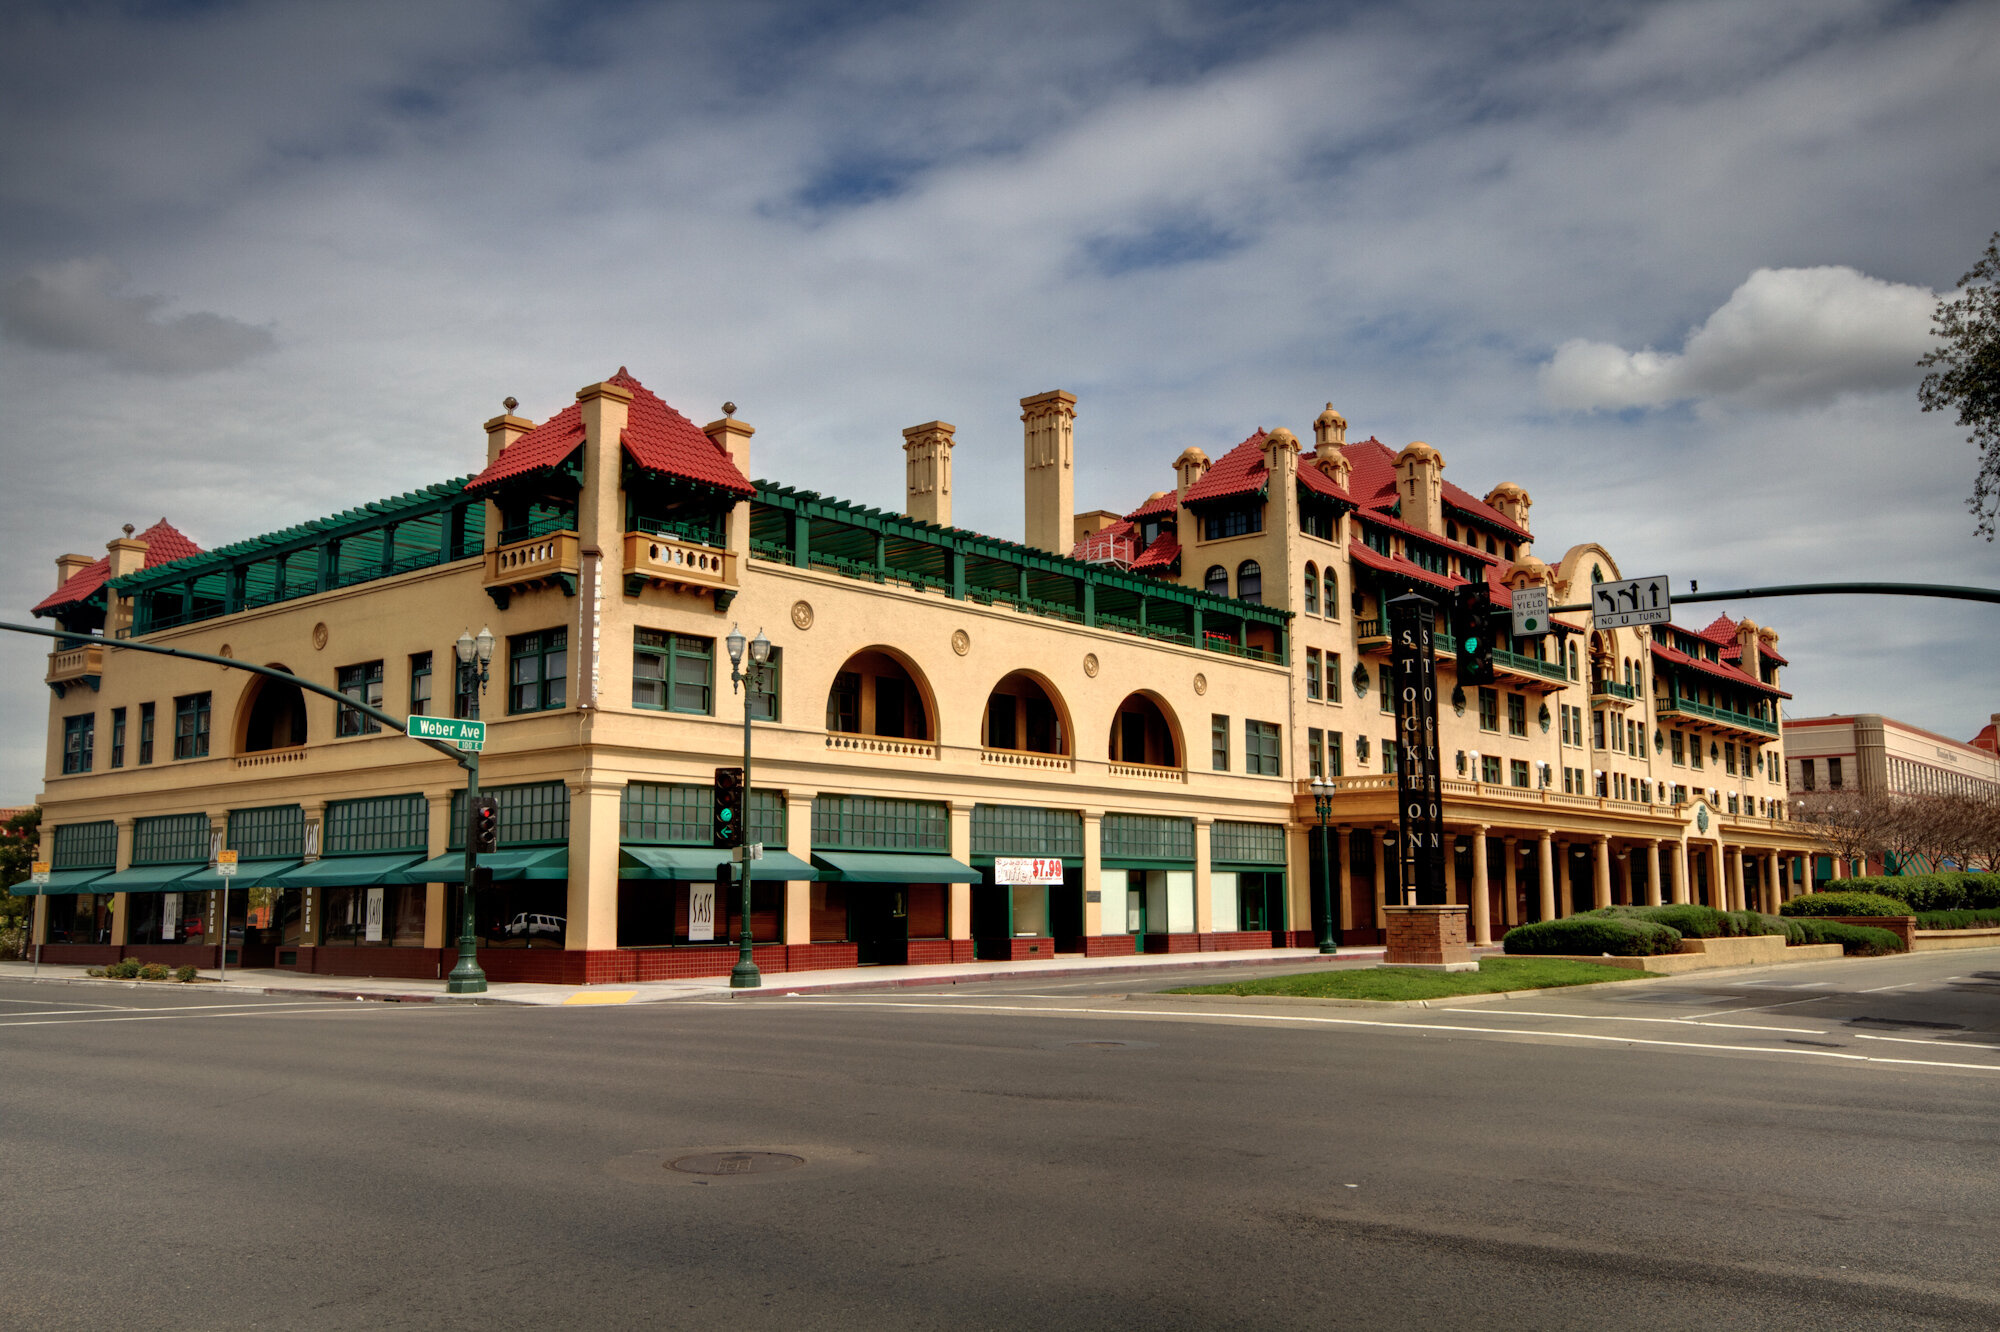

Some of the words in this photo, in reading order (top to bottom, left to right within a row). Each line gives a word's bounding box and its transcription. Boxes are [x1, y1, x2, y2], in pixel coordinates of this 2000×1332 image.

[1513, 593, 1528, 601] LEFT
[1530, 591, 1545, 599] TURN
[1516, 600, 1543, 609] YIELD
[1621, 616, 1629, 624] U
[1638, 612, 1662, 621] TURN
[420, 720, 455, 736] Weber
[460, 723, 480, 739] Ave
[1402, 629, 1423, 848] STOCKTON
[1422, 629, 1439, 848] STOCKTON
[462, 741, 472, 749] 100
[474, 742, 479, 750] E
[1033, 858, 1062, 879] $7.99
[693, 893, 712, 923] SASS
